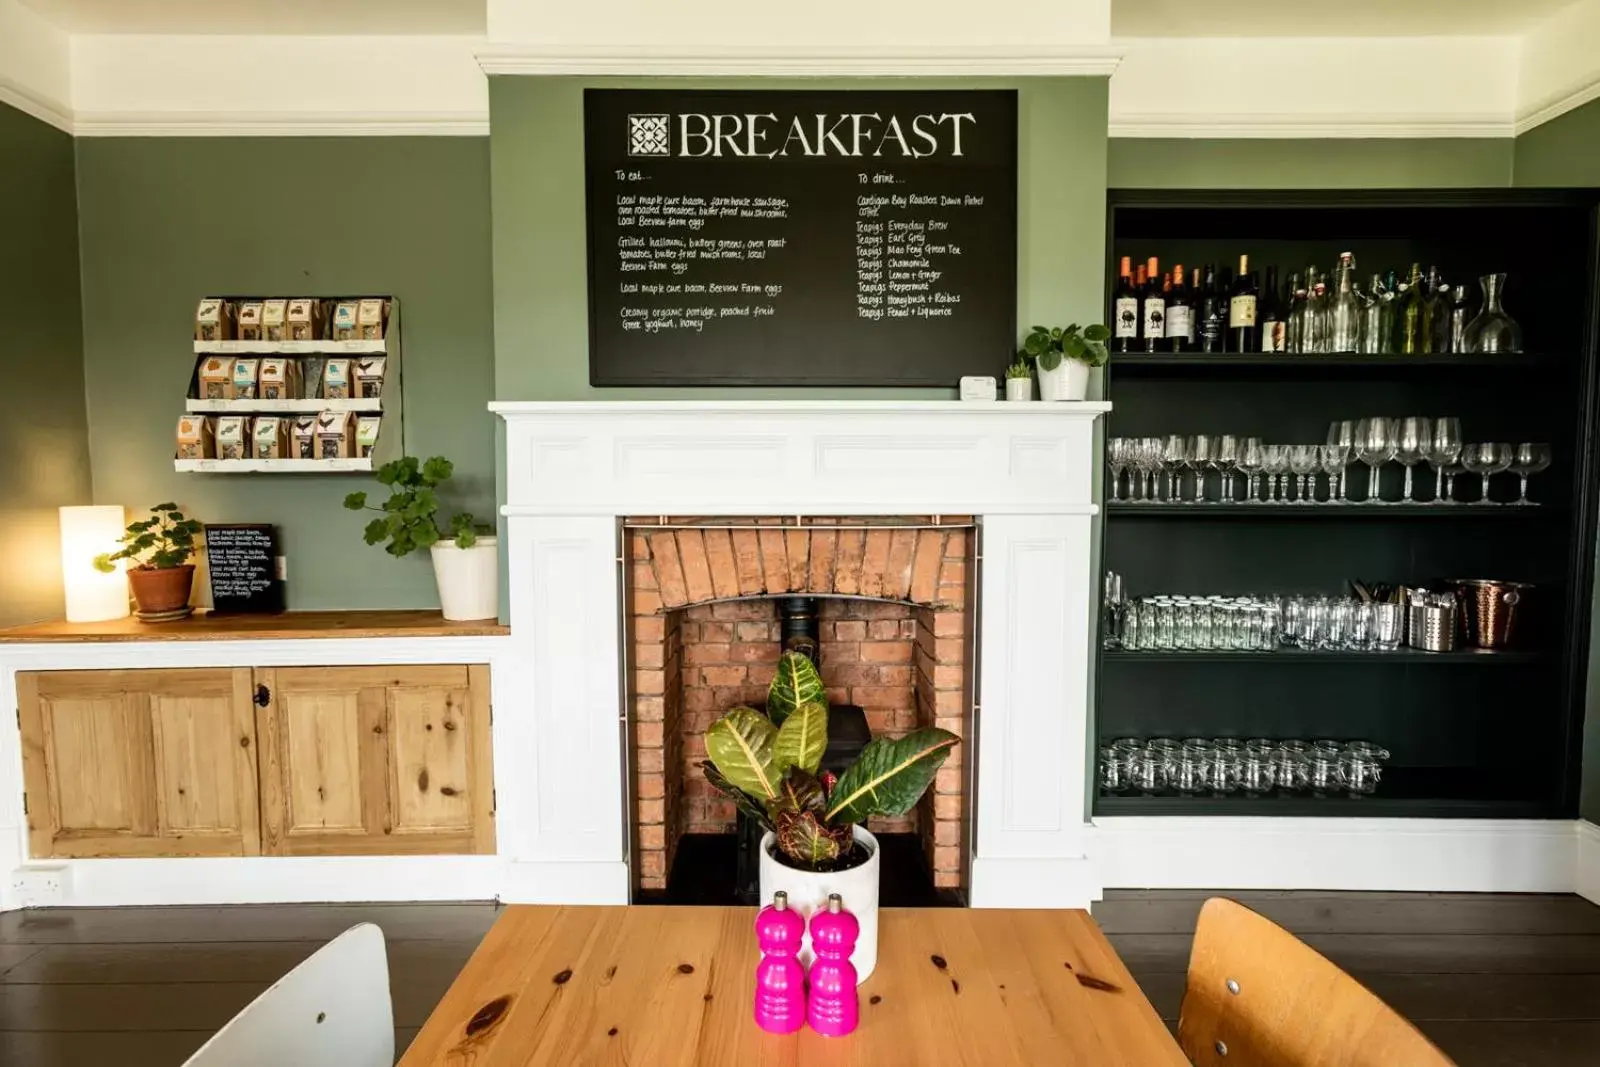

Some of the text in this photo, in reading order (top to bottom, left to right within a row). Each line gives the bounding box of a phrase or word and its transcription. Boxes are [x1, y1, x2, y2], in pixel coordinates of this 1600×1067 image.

[678, 112, 977, 159] BREAKFAST
[615, 170, 625, 181] To
[858, 173, 868, 184] To
[617, 194, 636, 205] Local
[639, 195, 662, 206] maple
[858, 194, 890, 209] Cardigan
[892, 194, 906, 208] Bay
[941, 196, 961, 206] Dawn
[618, 216, 635, 226] Local
[688, 218, 704, 230] eggs
[856, 220, 948, 234] Teapigs Everyday Brew
[618, 236, 645, 248] Grilled
[748, 240, 764, 248] oven
[856, 233, 926, 246] Teapigs Earl Grey
[856, 246, 882, 259] Teapigs
[906, 245, 922, 257] Feng
[925, 244, 946, 254] Green
[948, 244, 962, 254] Tea
[671, 262, 688, 274] eggs
[858, 258, 882, 271] Teapigs
[888, 270, 910, 280] Lemon
[620, 282, 638, 293] Local
[742, 284, 762, 292] Farm
[764, 284, 782, 296] eggs
[652, 307, 682, 320] organic
[680, 319, 703, 332] honey
